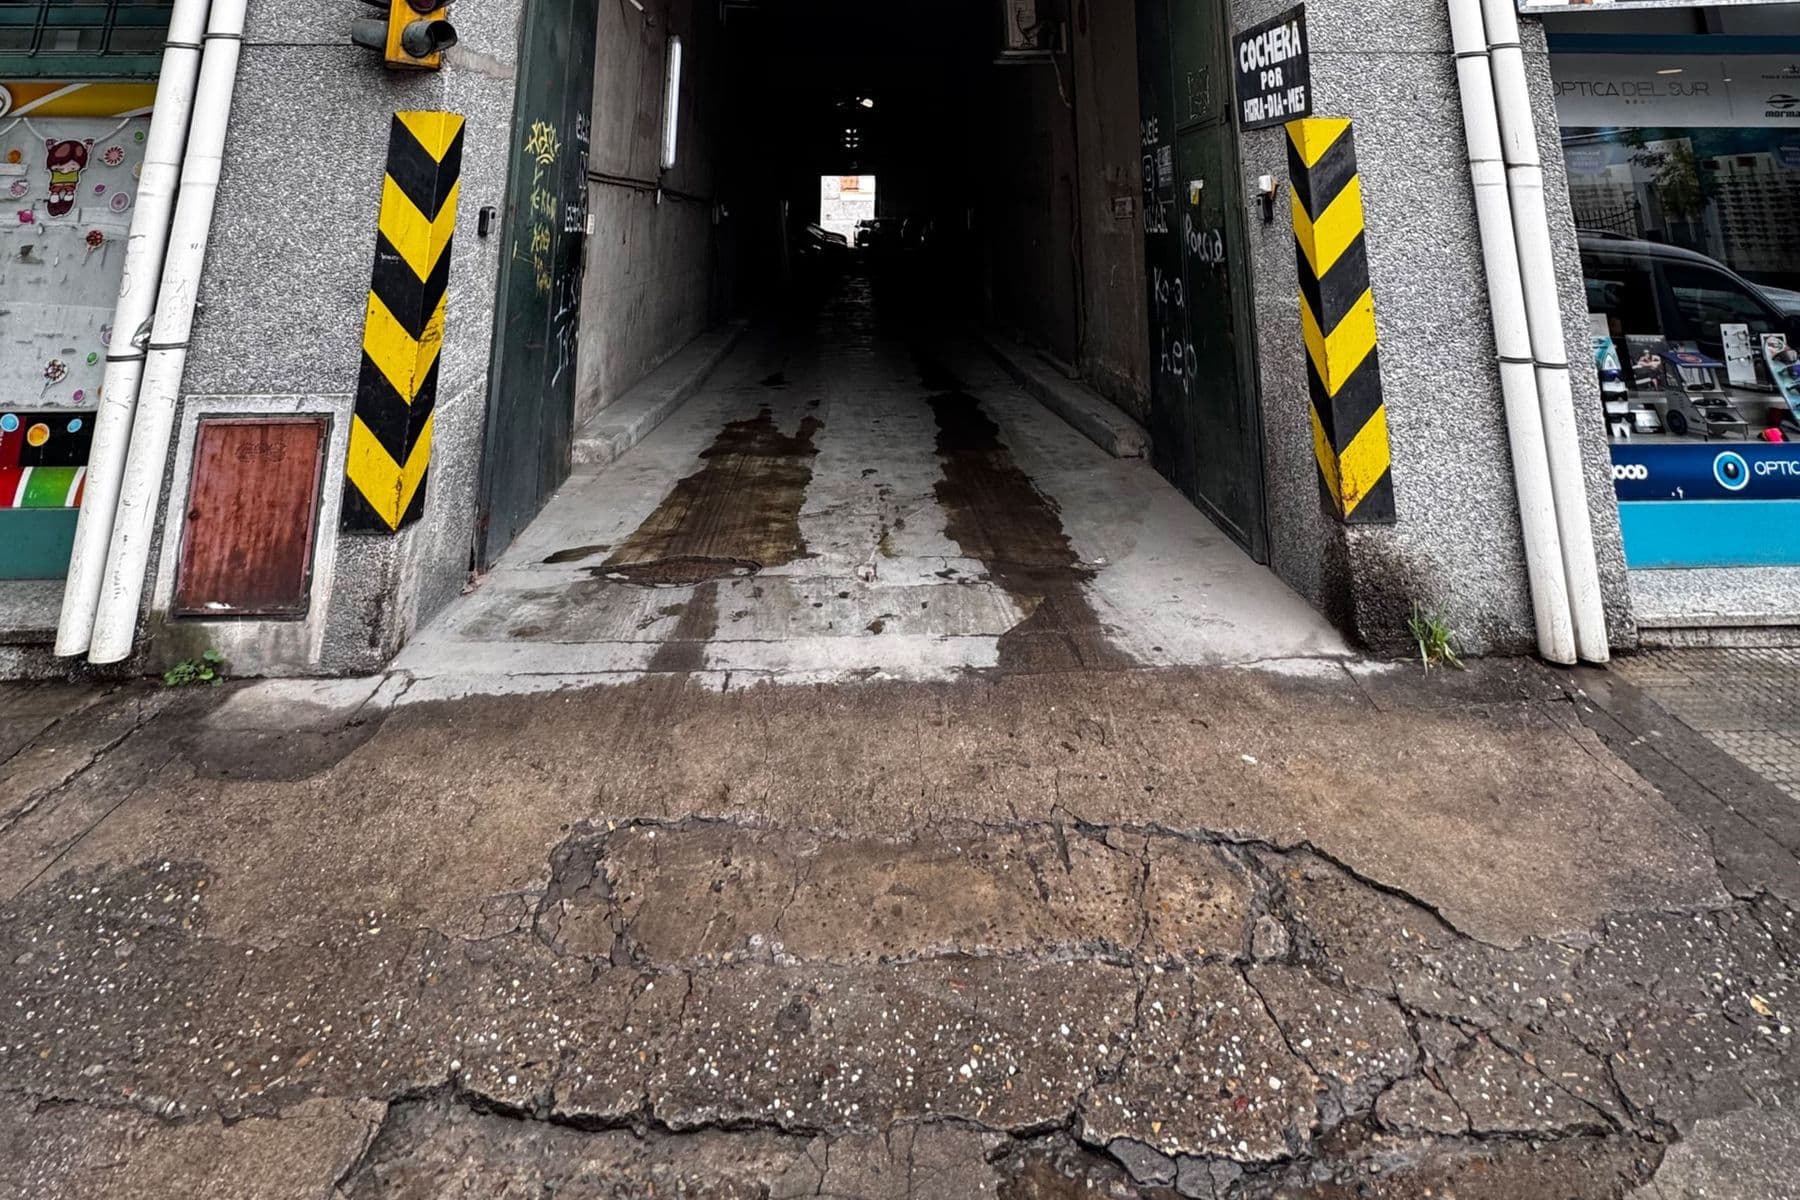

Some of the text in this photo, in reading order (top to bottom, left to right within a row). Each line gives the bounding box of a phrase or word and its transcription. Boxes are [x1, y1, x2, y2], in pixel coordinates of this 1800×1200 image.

[1240, 20, 1302, 74] COCHERA
[1260, 66, 1284, 91] POR
[1552, 81, 1710, 97] OPTICA DEL SUR
[1243, 85, 1306, 123] HORA-DIA-MES
[1612, 464, 1648, 480] OOD
